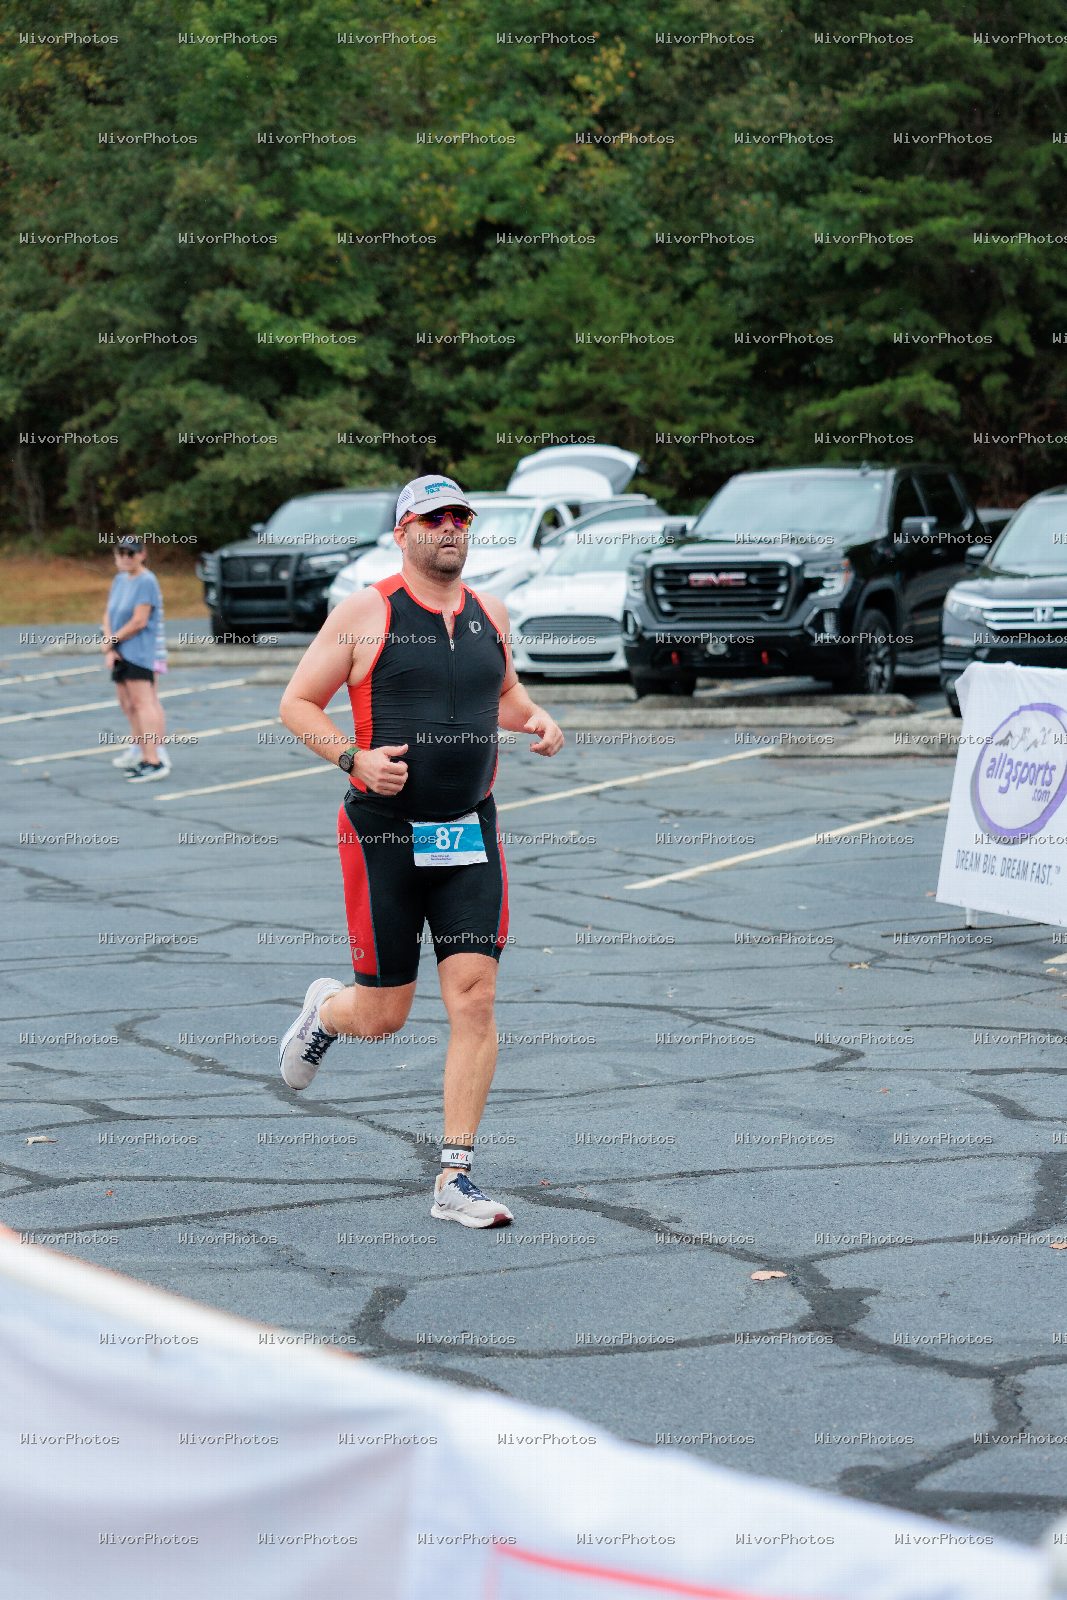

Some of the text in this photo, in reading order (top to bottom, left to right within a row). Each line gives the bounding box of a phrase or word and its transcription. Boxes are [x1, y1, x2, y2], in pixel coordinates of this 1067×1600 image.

[688, 572, 746, 587] GMC
[986, 753, 1057, 794] all3sports
[435, 827, 464, 850] 87
[955, 849, 981, 872] DREAM
[982, 854, 997, 876] BIG.
[1000, 857, 1028, 880] DREAM
